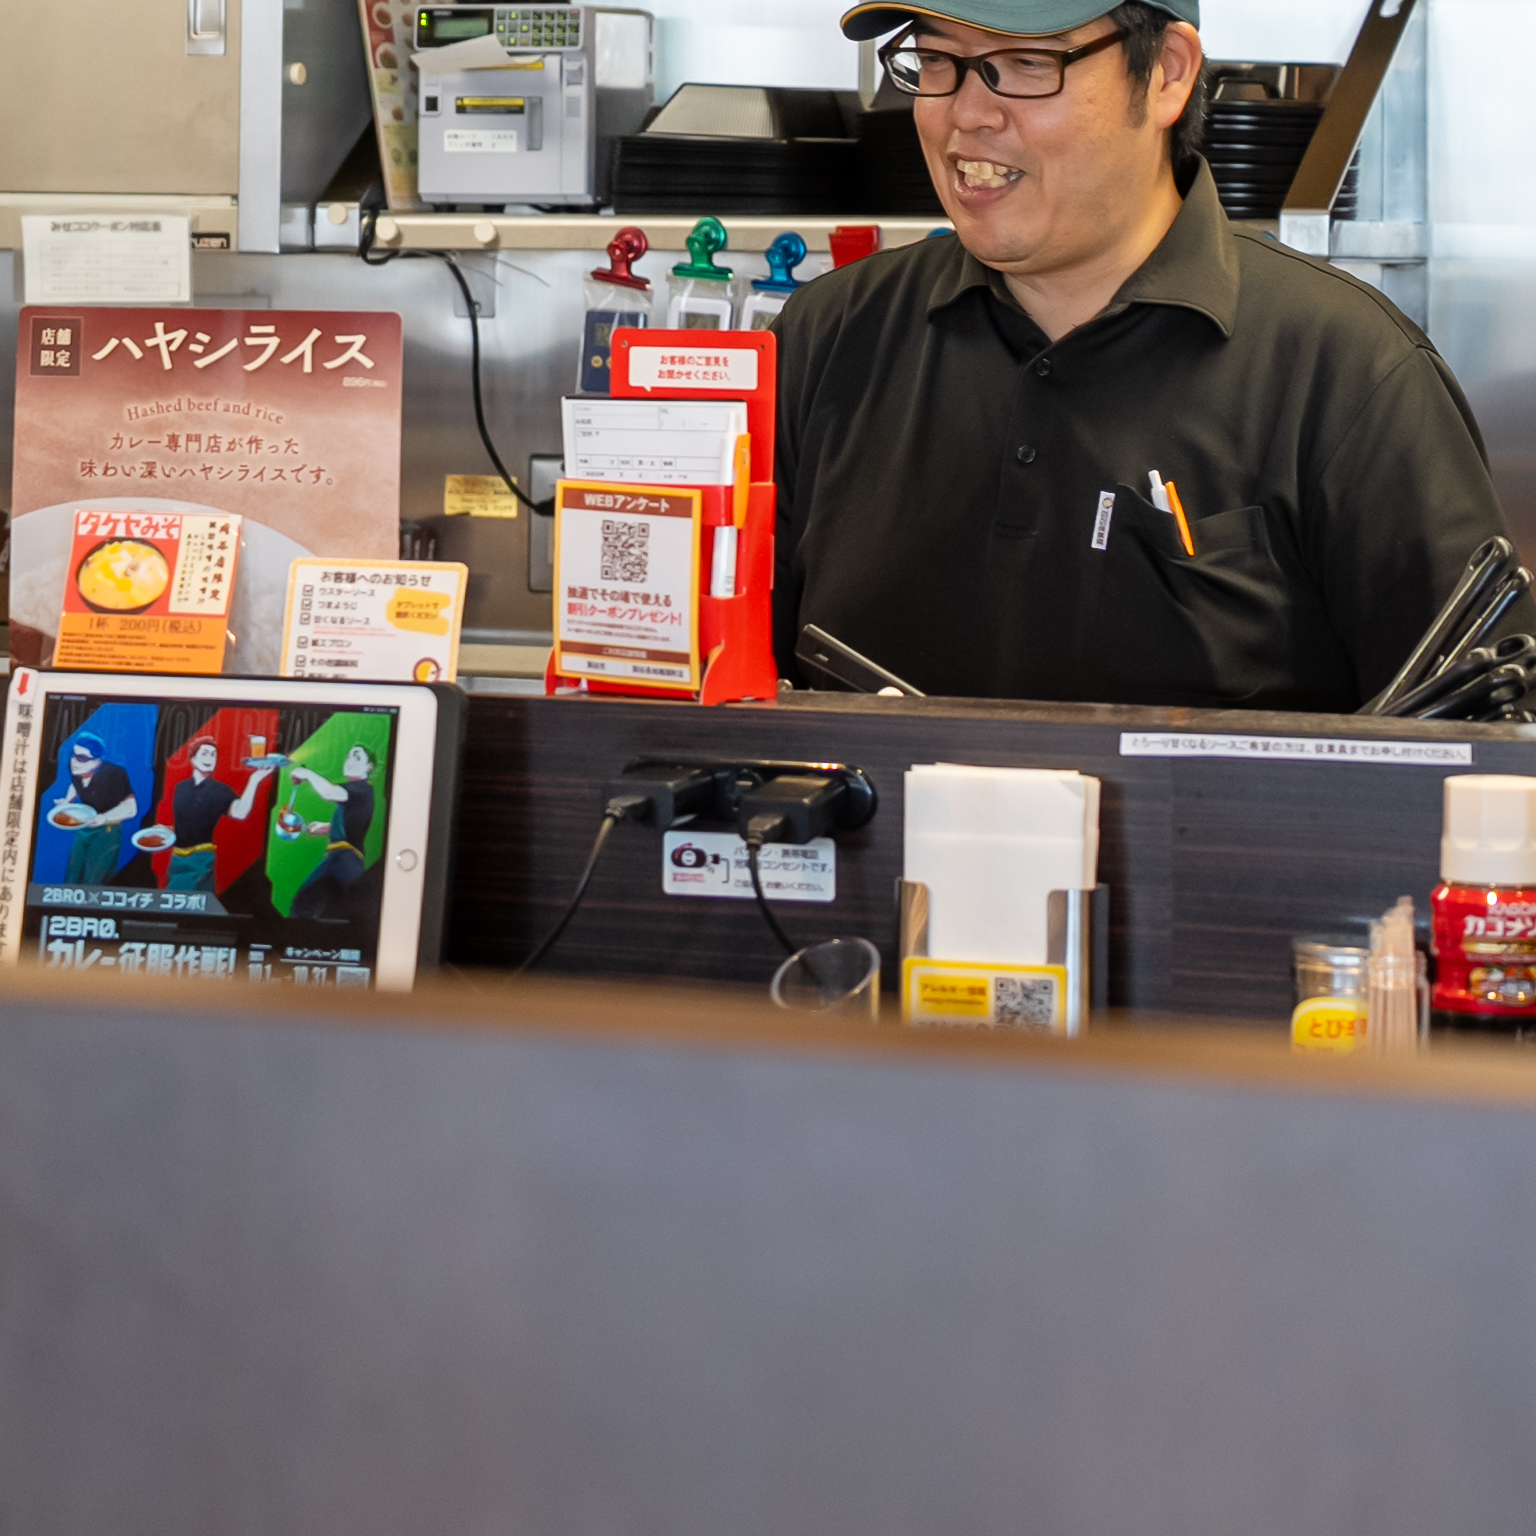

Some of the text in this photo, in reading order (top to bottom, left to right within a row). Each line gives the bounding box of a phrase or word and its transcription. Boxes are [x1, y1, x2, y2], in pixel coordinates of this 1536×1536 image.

[41, 328, 72, 346] 店舗
[91, 321, 376, 373] ハヤシライス
[39, 350, 71, 368] 限定
[127, 396, 284, 425] Hashed beef and rice
[109, 432, 300, 455] カレー専門店が作った
[80, 461, 334, 486] 味わい深いハヤシライスです。
[584, 493, 670, 513] WEBアンケート
[82, 512, 179, 539] タケヤみそ
[320, 571, 432, 587] お客様へのお知らせ
[159, 891, 206, 911] コラボ!
